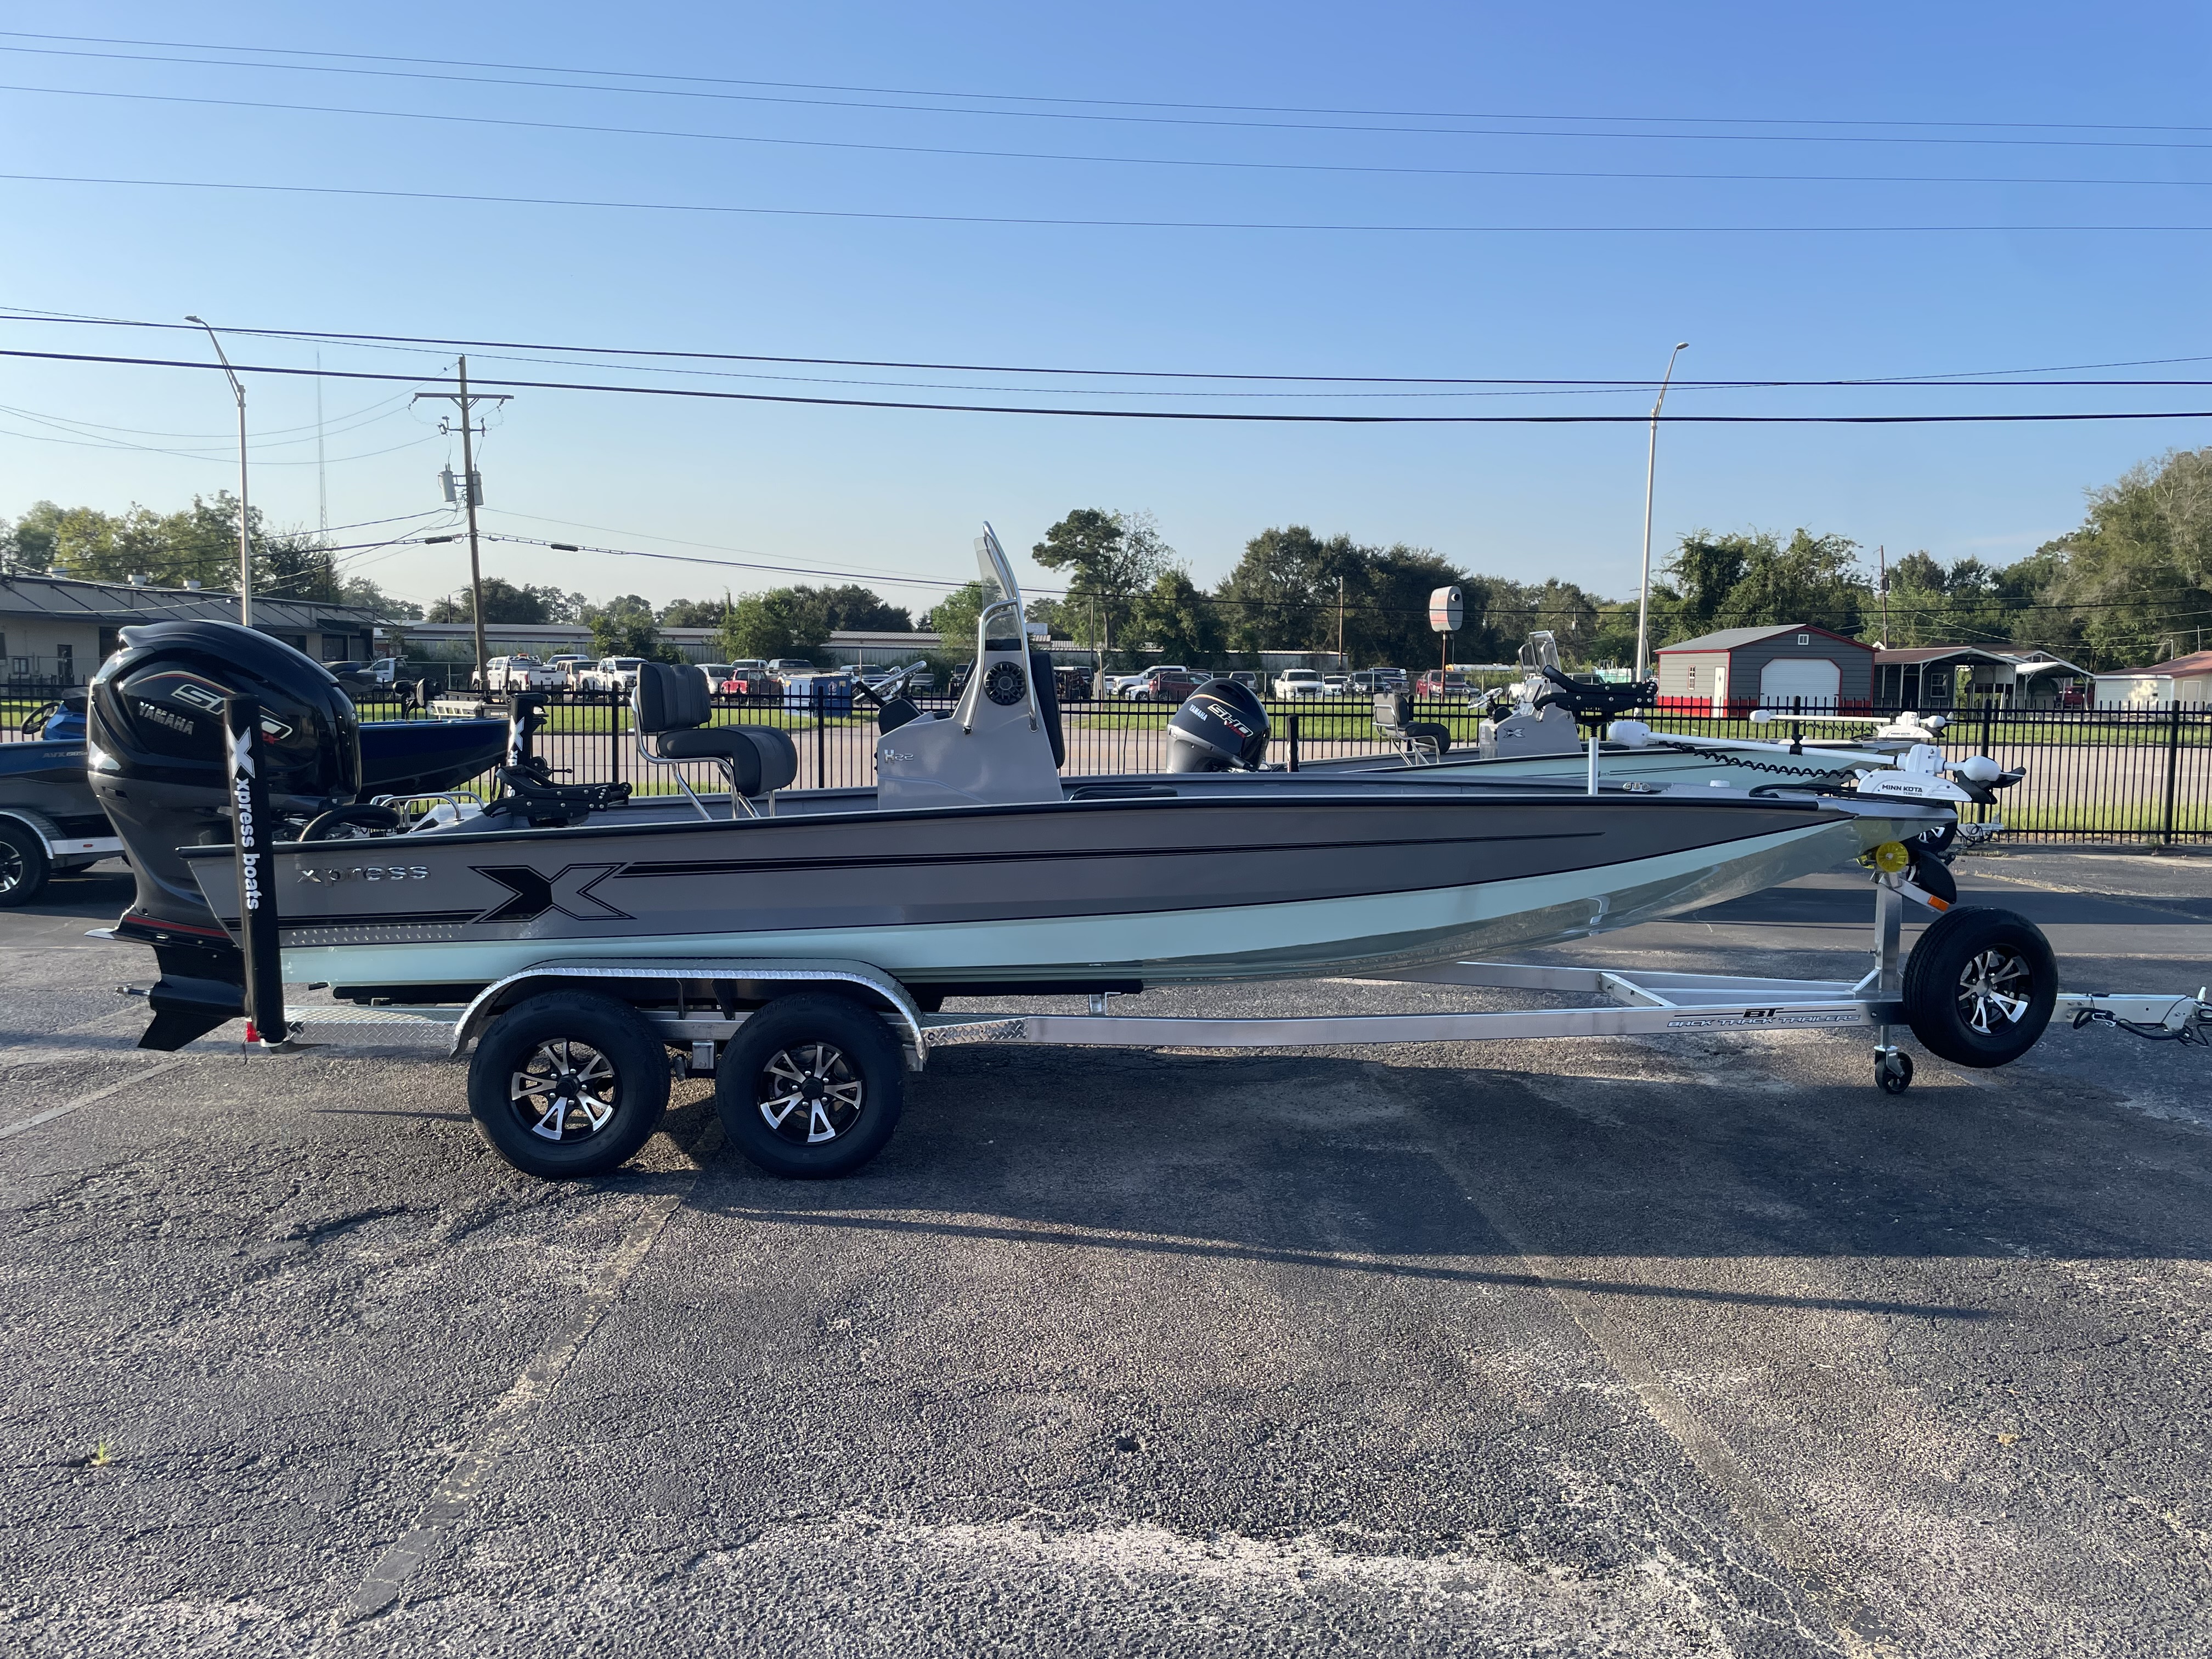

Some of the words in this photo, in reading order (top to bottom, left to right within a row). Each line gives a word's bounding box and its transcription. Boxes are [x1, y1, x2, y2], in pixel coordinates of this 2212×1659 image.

[139, 701, 194, 735] YAMAHA
[1189, 704, 1208, 721] YAMAHA
[1207, 703, 1254, 737] SHO
[243, 853, 263, 910] boats
[296, 865, 431, 887] xpress
[1667, 1019, 1716, 1028] BACK
[1718, 1017, 1777, 1026] TRACK
[1779, 1015, 1860, 1024] TRAILERS
